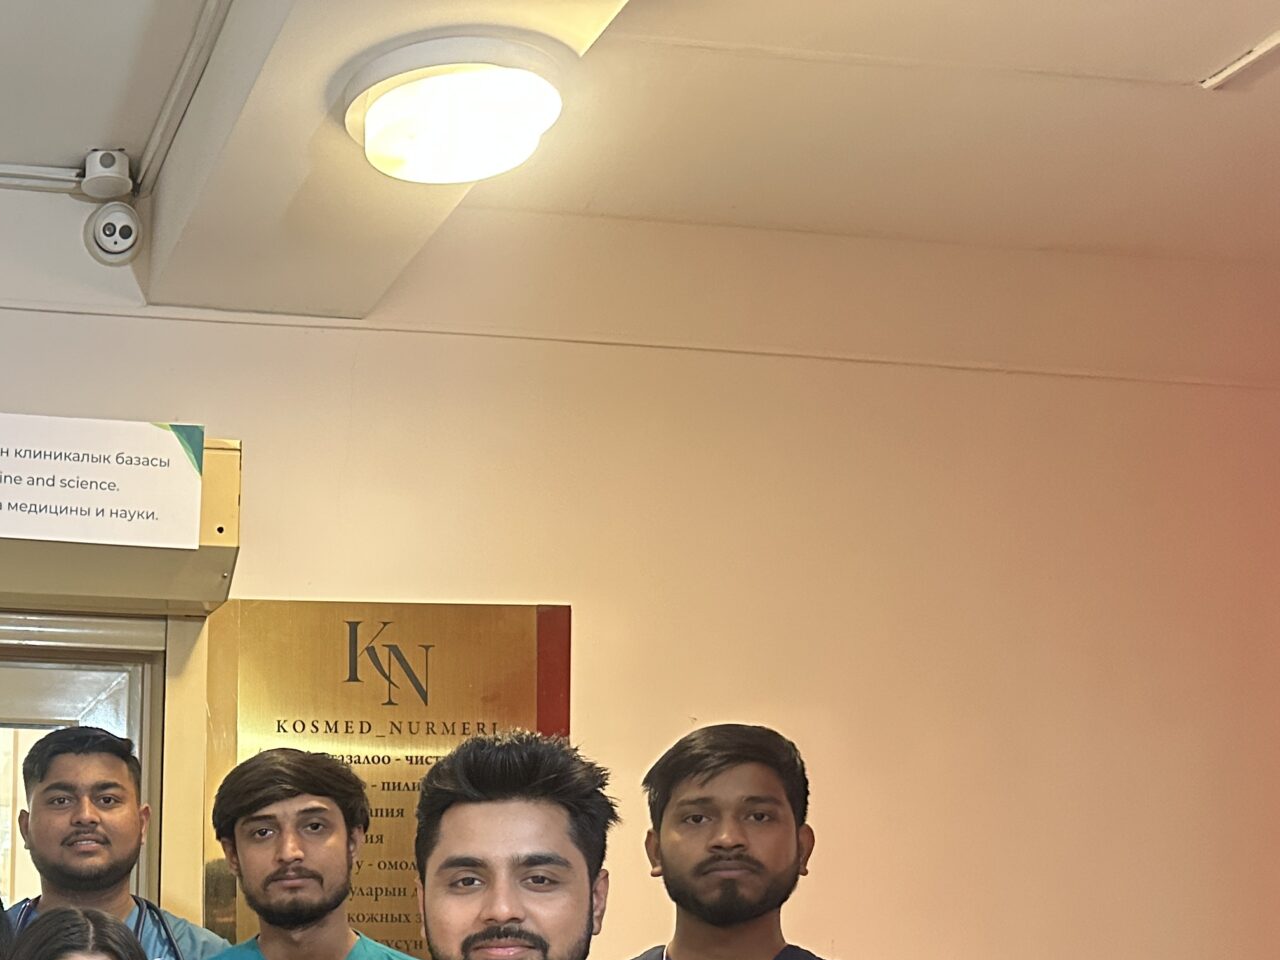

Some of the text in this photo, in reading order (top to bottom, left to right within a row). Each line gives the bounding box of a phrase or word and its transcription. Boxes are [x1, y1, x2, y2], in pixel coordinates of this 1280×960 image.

[14, 448, 112, 464] клиникалык
[115, 451, 170, 468] базасы
[26, 475, 56, 487] and
[59, 476, 120, 492] science.
[7, 501, 91, 516] медицины
[95, 507, 105, 518] и
[109, 508, 159, 522] науки.
[404, 755, 443, 766] чист
[381, 781, 421, 792] пили
[377, 860, 417, 871] омол
